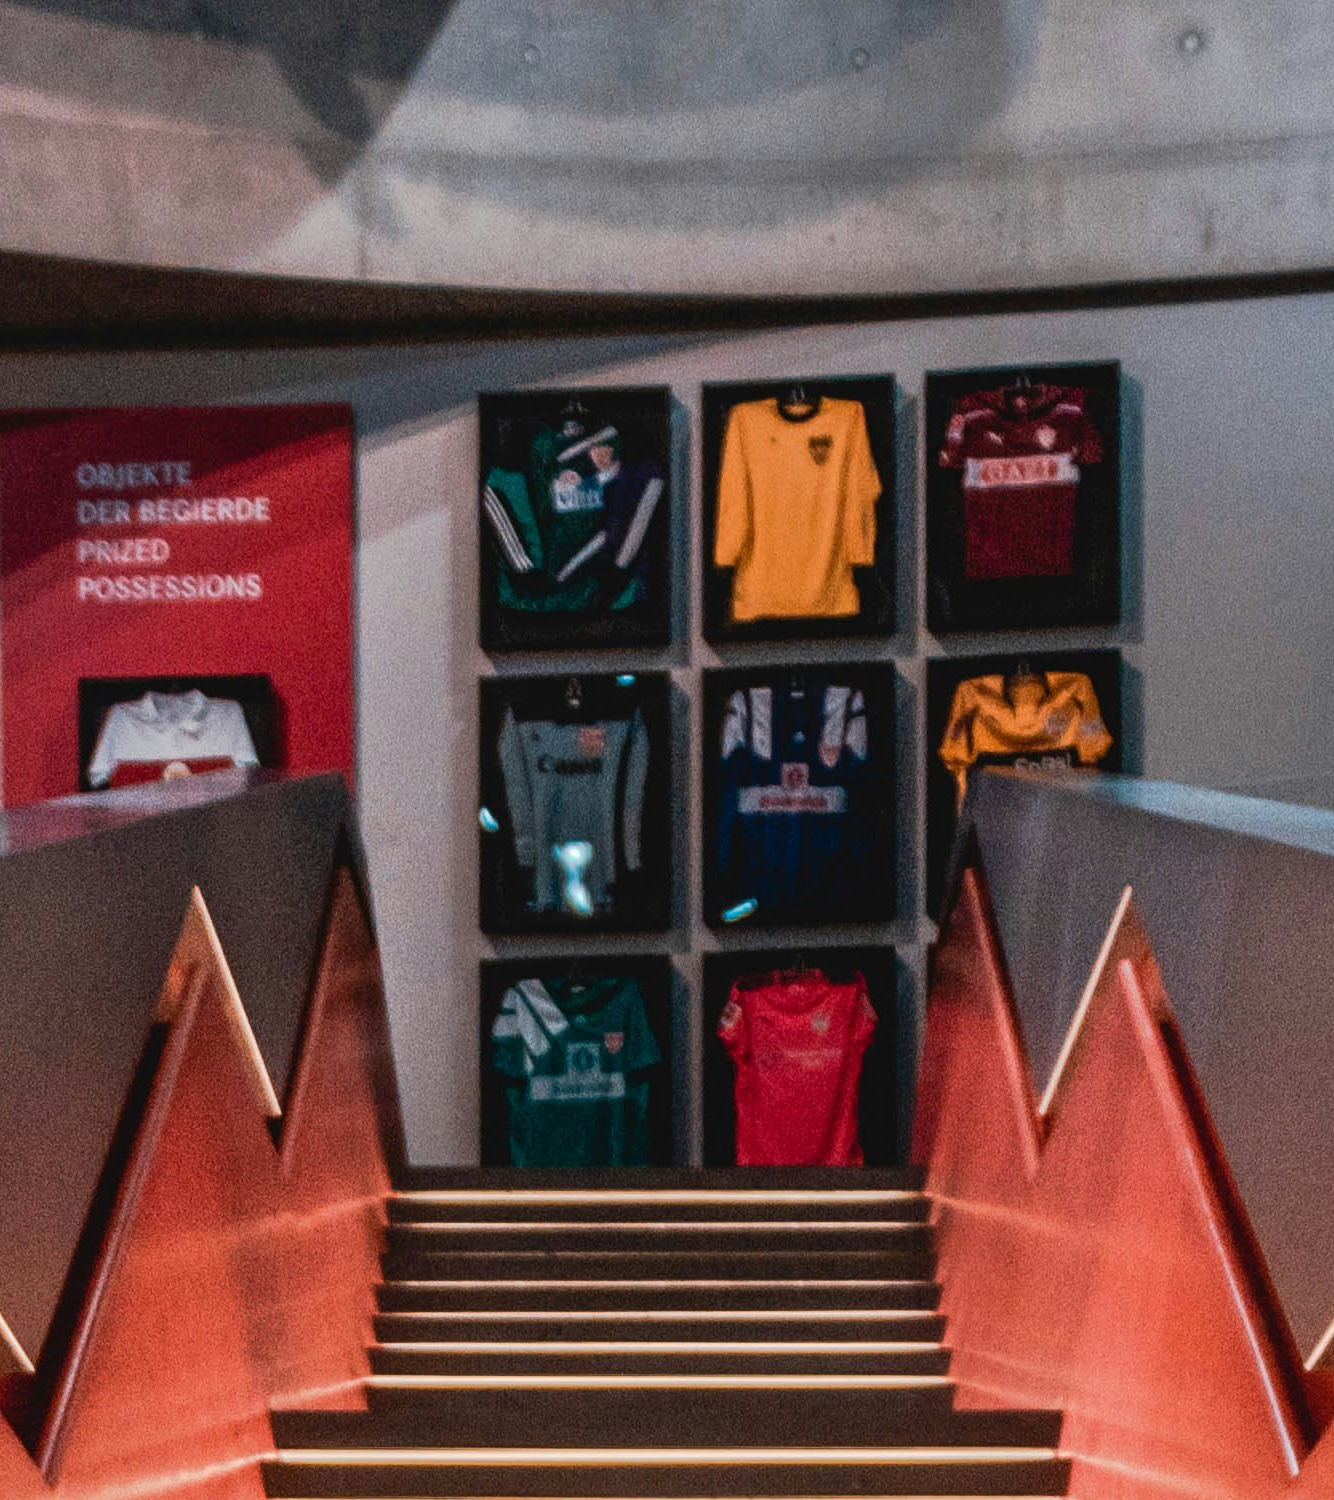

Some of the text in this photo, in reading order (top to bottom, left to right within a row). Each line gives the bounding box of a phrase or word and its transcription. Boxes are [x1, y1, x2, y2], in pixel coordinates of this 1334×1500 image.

[76, 461, 193, 488] OBJEKTE
[77, 497, 271, 525] DER BEGIERDE
[77, 538, 171, 564] PRIZED
[77, 573, 263, 601] POSSESSIONS
